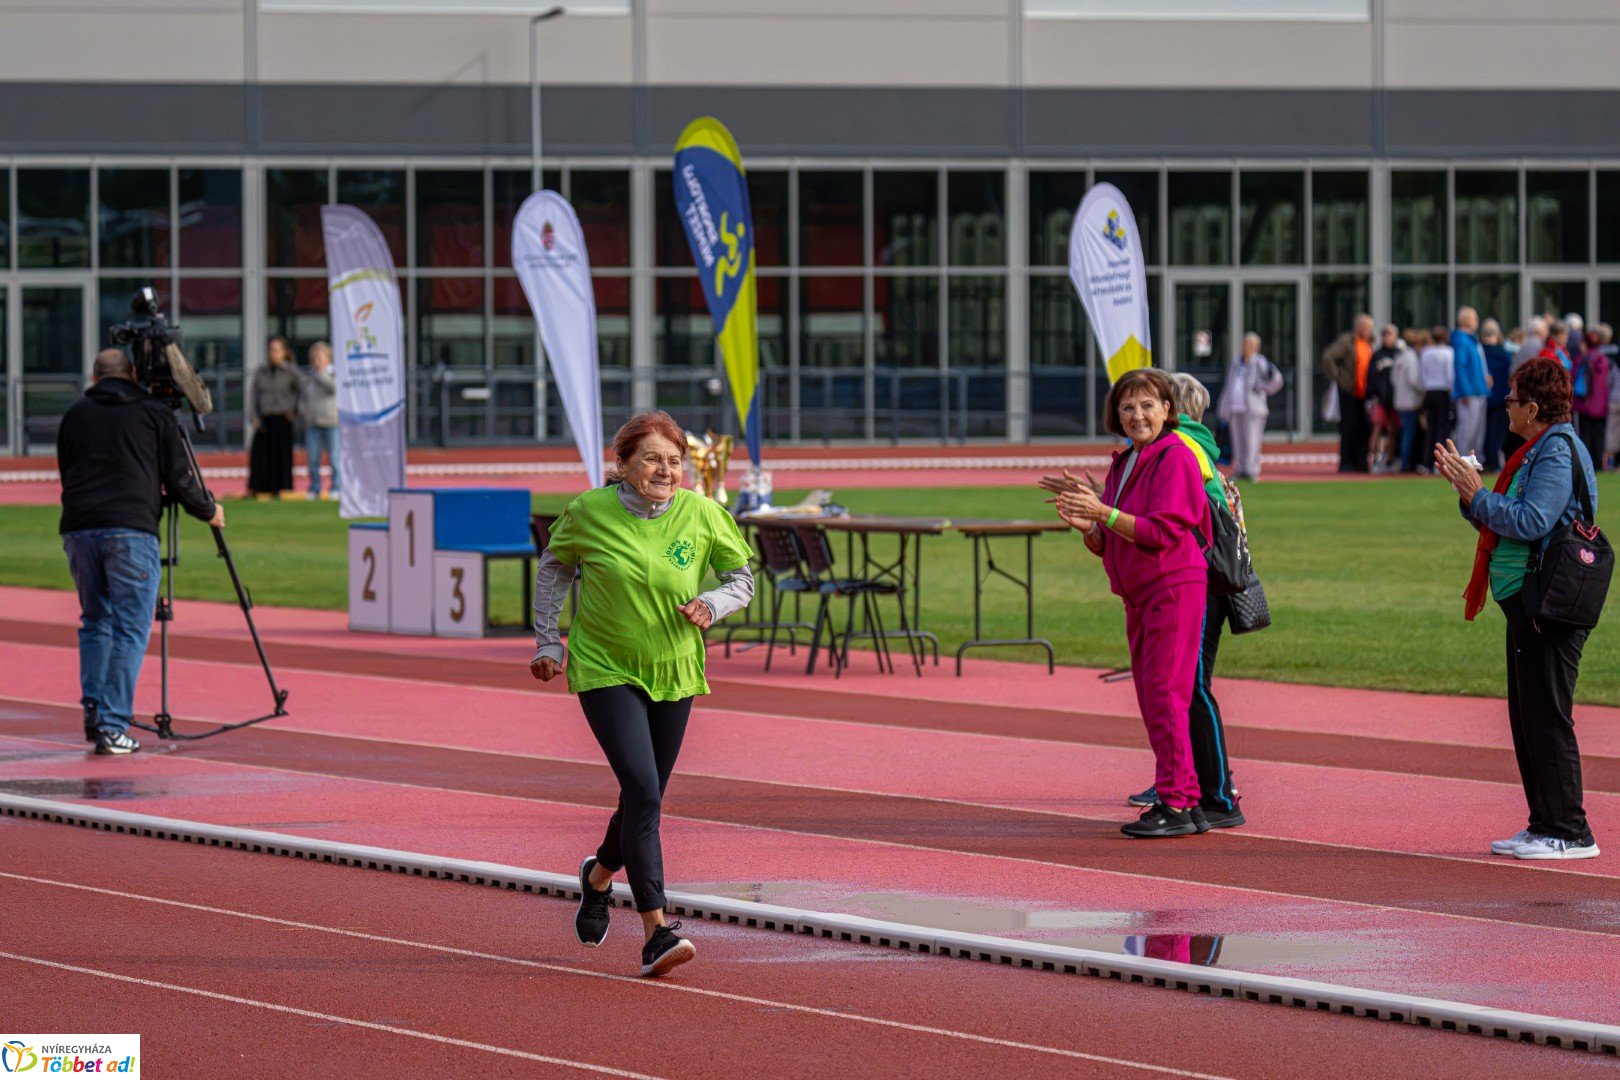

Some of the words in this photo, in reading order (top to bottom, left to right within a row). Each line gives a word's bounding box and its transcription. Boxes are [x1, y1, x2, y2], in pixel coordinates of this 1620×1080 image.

[405, 510, 415, 568] 1
[362, 545, 376, 602] 2
[450, 567, 465, 623] 3
